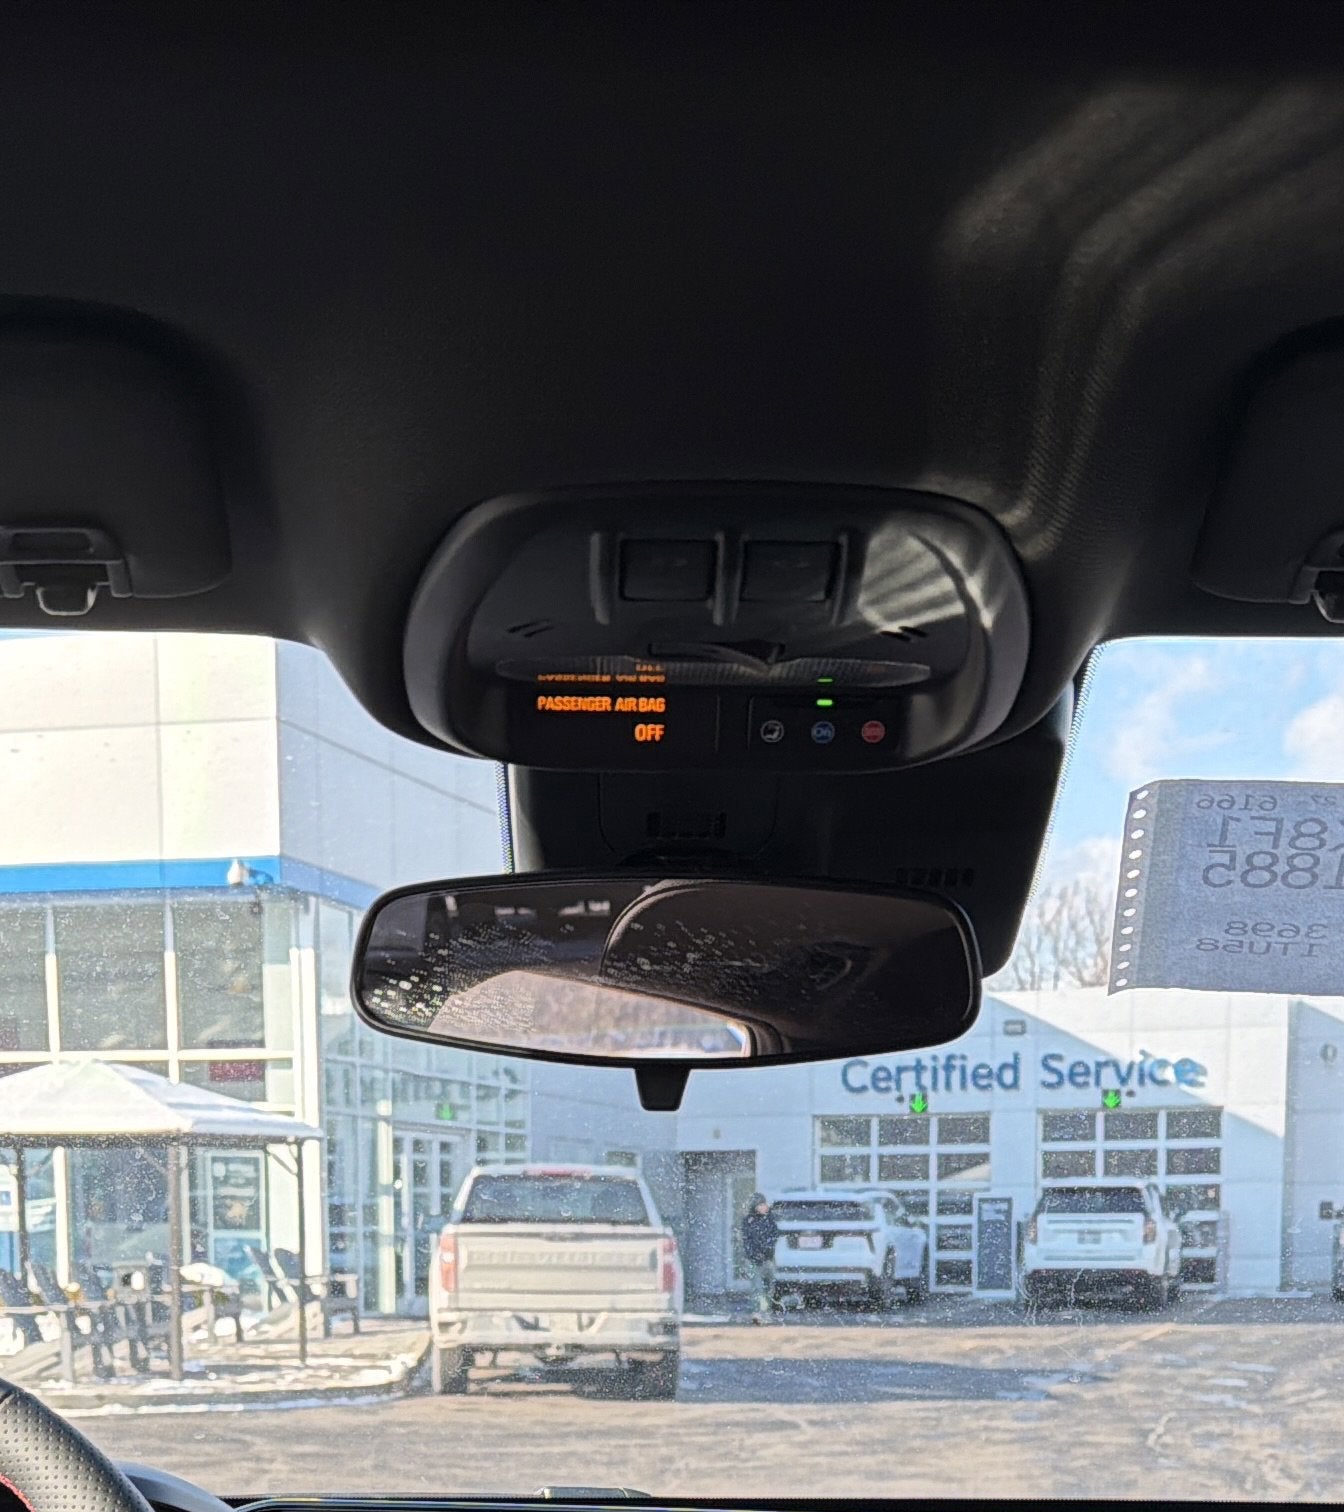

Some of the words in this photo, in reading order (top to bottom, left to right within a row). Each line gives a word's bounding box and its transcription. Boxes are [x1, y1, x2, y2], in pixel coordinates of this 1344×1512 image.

[536, 694, 613, 714] PASSENGER
[614, 695, 638, 713] AIR
[639, 695, 666, 714] BAG
[634, 722, 665, 743] OFF
[840, 1053, 1021, 1094] Certified
[1040, 1051, 1208, 1090] Service
